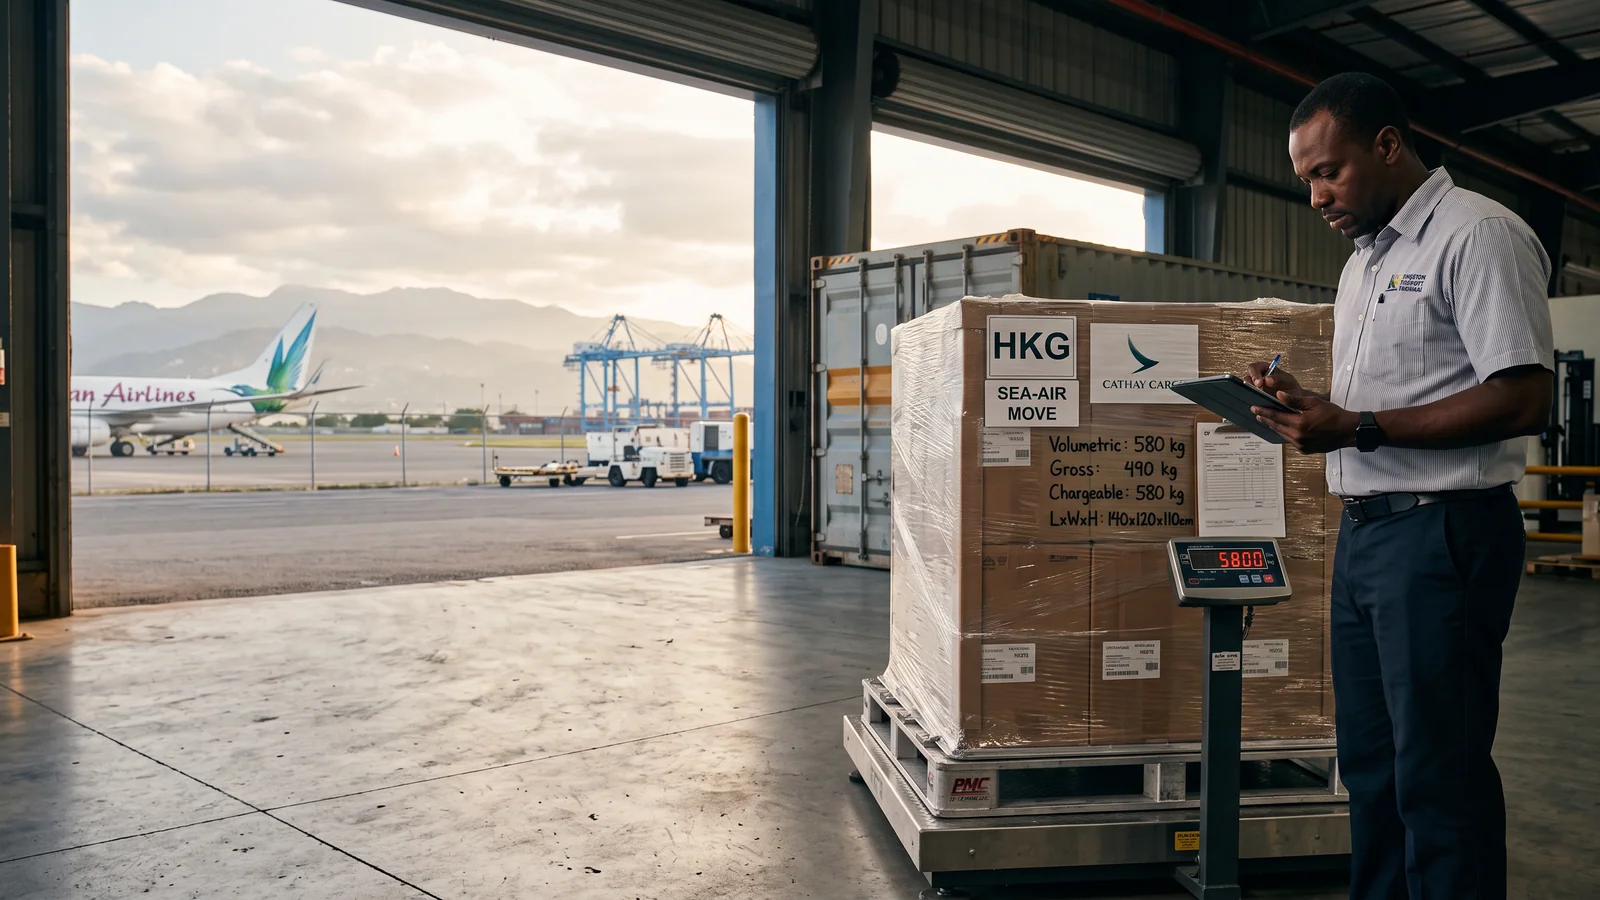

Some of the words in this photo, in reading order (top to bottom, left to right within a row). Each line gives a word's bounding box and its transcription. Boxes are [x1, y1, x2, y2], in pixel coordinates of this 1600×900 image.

[994, 332, 1070, 360] HKG
[1103, 379, 1146, 389] CATHAY
[1149, 379, 1186, 389] CAR
[101, 382, 195, 407] Airlines
[997, 386, 1067, 400] SEA-AIR
[1008, 407, 1057, 420] MOVE
[1049, 436, 1128, 452] Volumetric:
[1134, 435, 1165, 452] 580
[1170, 438, 1185, 459] kg
[1050, 459, 1100, 476] Gross:
[1124, 461, 1154, 477] 490
[1161, 461, 1177, 480] kg
[1049, 484, 1129, 505] Chargeable:
[1136, 485, 1165, 500] 580
[1169, 485, 1185, 505] kg
[1050, 511, 1104, 526] LxWxH:
[1108, 512, 1194, 526] 140x120x110cm
[1219, 552, 1263, 567] 5800
[952, 778, 990, 793] PMC
